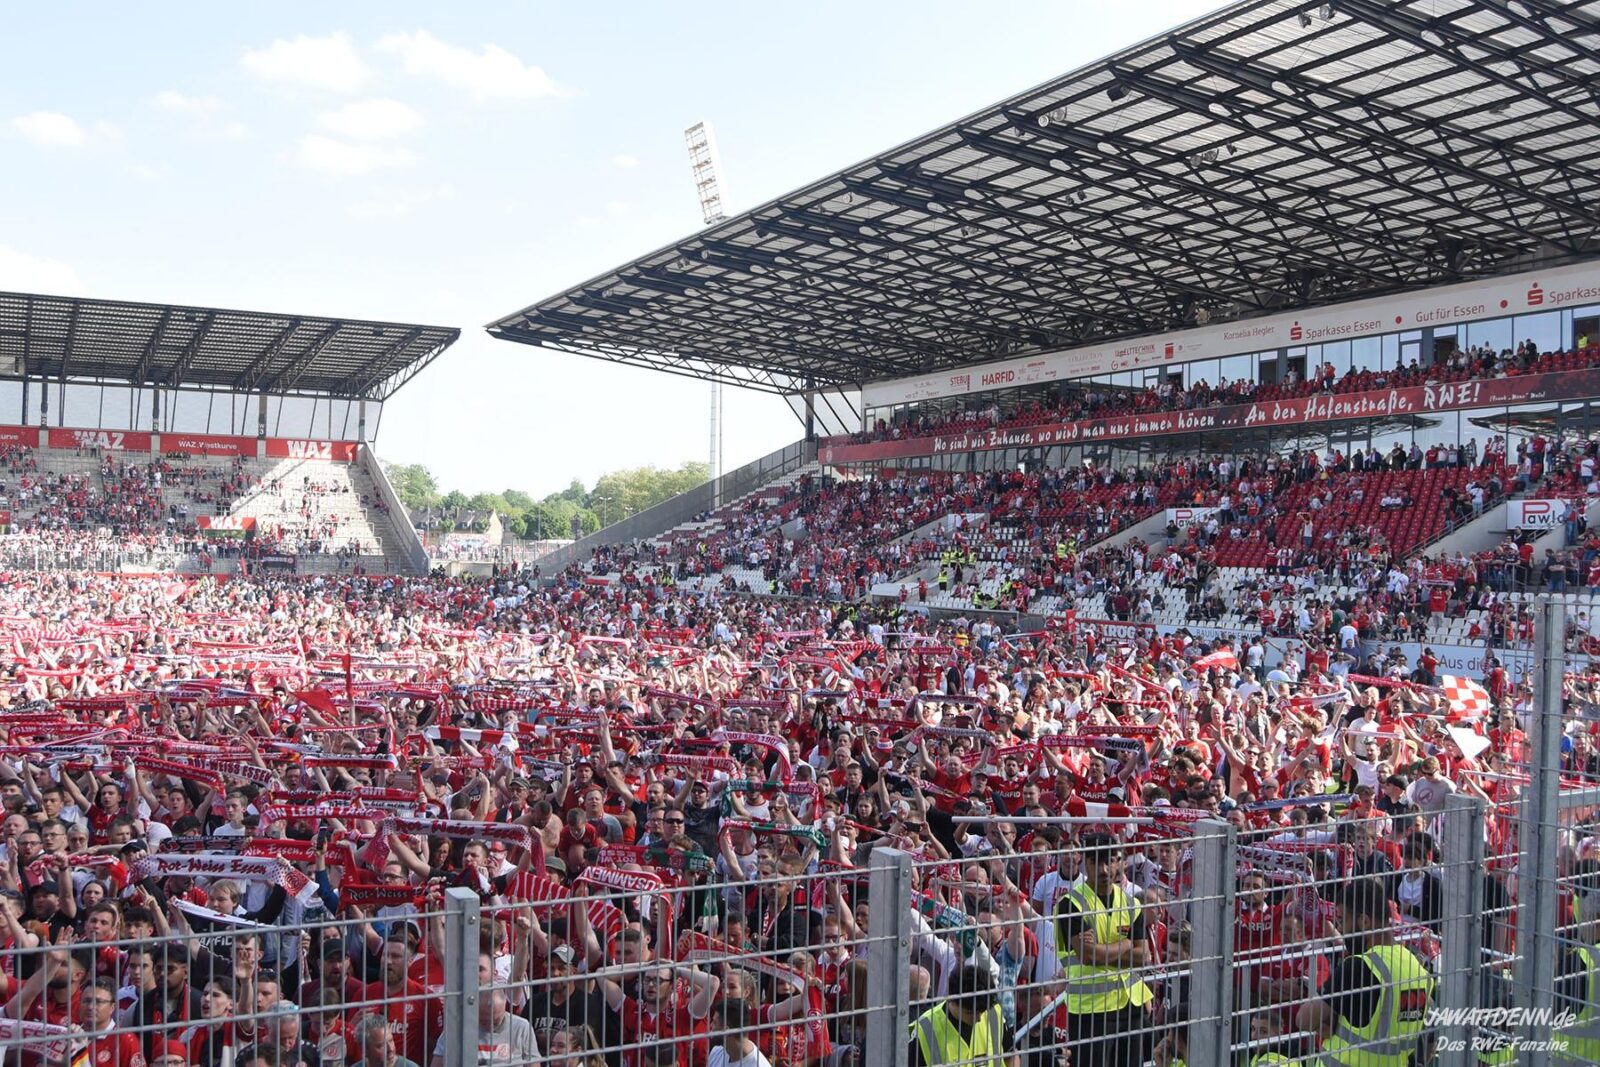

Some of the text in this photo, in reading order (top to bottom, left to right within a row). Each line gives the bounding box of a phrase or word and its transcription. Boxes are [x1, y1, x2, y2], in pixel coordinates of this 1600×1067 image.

[1416, 303, 1485, 323] Gut für Essen
[1306, 318, 1381, 339] Sparkasse Essen
[982, 370, 1015, 386] HARFID
[934, 436, 947, 453] Wo
[949, 435, 969, 451] sind
[971, 433, 987, 449] wir
[989, 426, 1034, 448] Zuhause,
[1038, 429, 1053, 443] wo
[1055, 422, 1078, 442] wird
[1082, 424, 1106, 438] man
[1110, 422, 1130, 435] uns
[1134, 417, 1172, 434] immer
[1177, 409, 1215, 431] hören
[1244, 405, 1266, 426] An
[1272, 402, 1297, 421] der
[1303, 390, 1413, 420] Hafenstraße,
[1423, 382, 1481, 410] RWE!
[287, 440, 333, 459] WAZ
[1439, 655, 1463, 669] Aus
[264, 805, 377, 821] EIN LEBEN LANG
[268, 845, 303, 857] Essen.
[157, 858, 267, 875] Rot-Weiss Essen
[348, 887, 409, 901] Rot-Weiss
